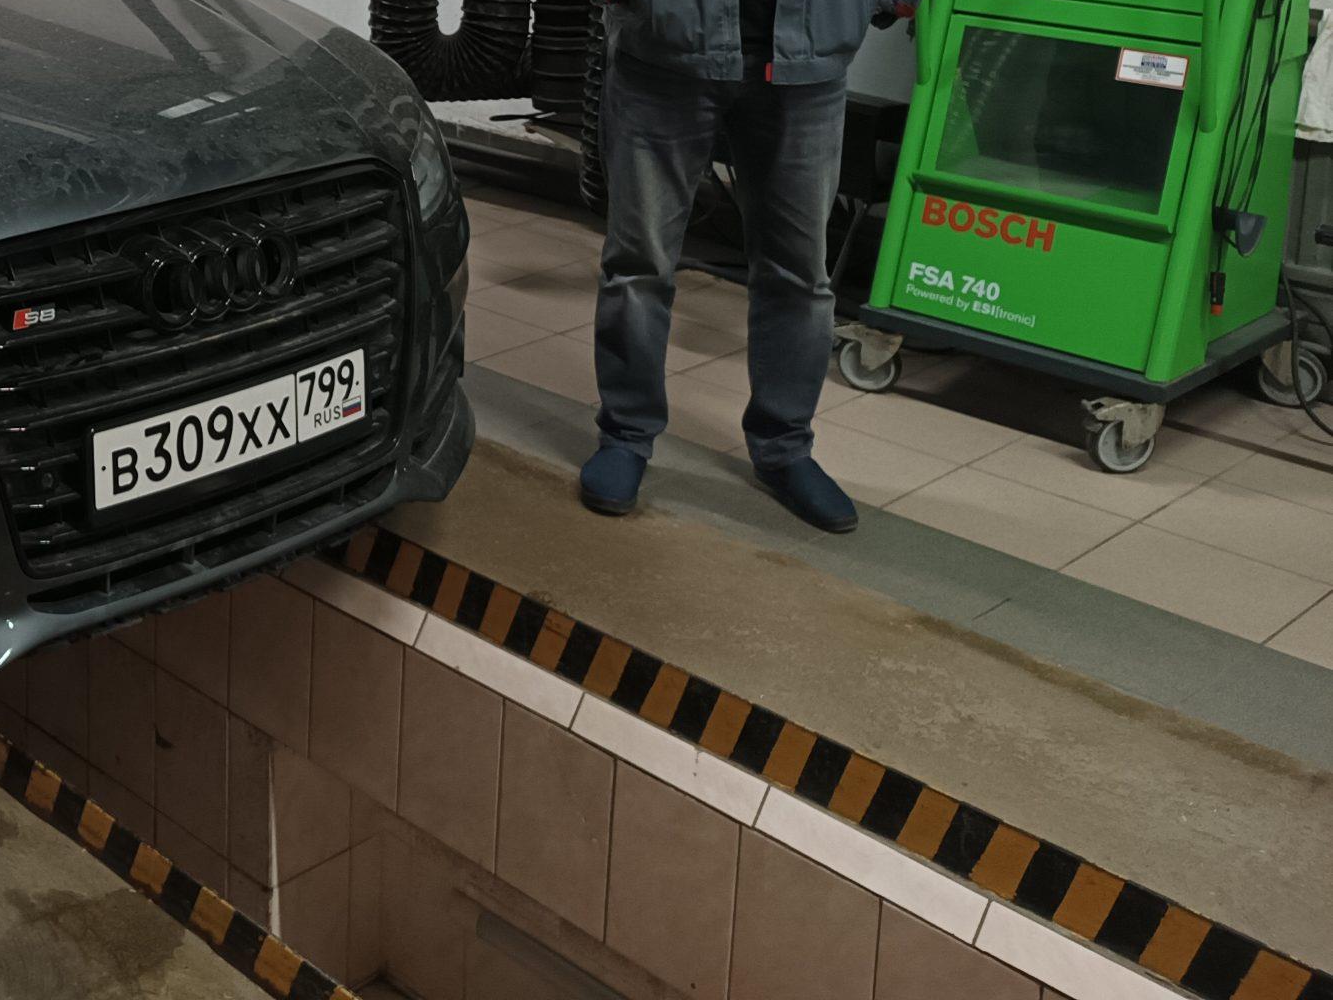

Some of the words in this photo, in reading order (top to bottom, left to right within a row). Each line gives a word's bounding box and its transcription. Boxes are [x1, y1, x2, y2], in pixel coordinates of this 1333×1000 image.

[921, 195, 1057, 252] BOSCH
[905, 283, 954, 306] Powered
[956, 297, 970, 313] by
[908, 261, 954, 291] FSA
[961, 275, 1000, 301] 740
[299, 359, 355, 416] 799
[314, 406, 341, 428] RUS
